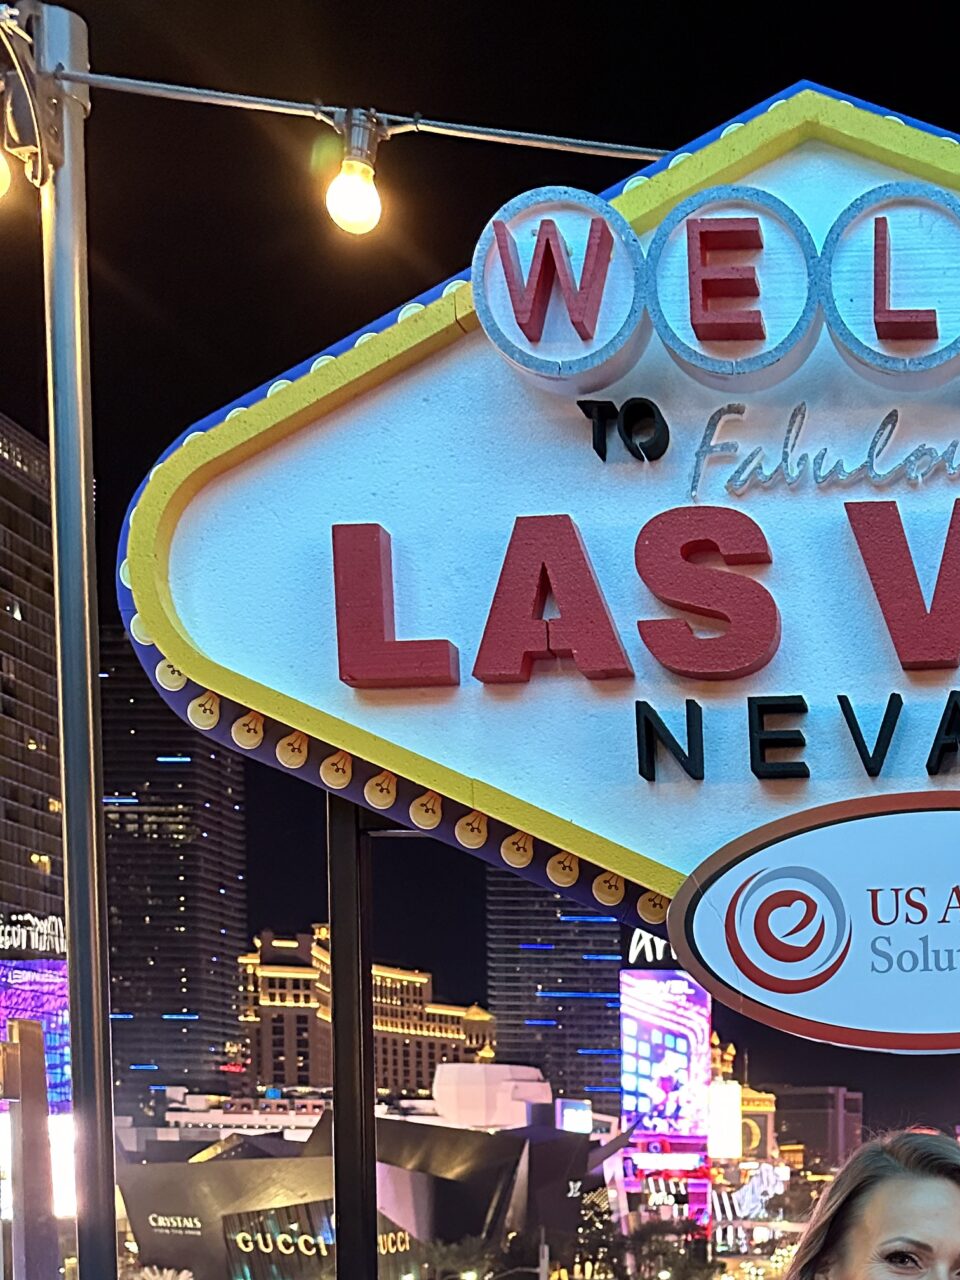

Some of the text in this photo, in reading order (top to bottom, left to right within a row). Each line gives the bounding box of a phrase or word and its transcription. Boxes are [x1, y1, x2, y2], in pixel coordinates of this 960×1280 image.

[576, 396, 670, 463] TO
[332, 505, 782, 687] LAS
[866, 886, 929, 926] US
[235, 1231, 328, 1257] GUCCI
[378, 1231, 410, 1255] UCCI
